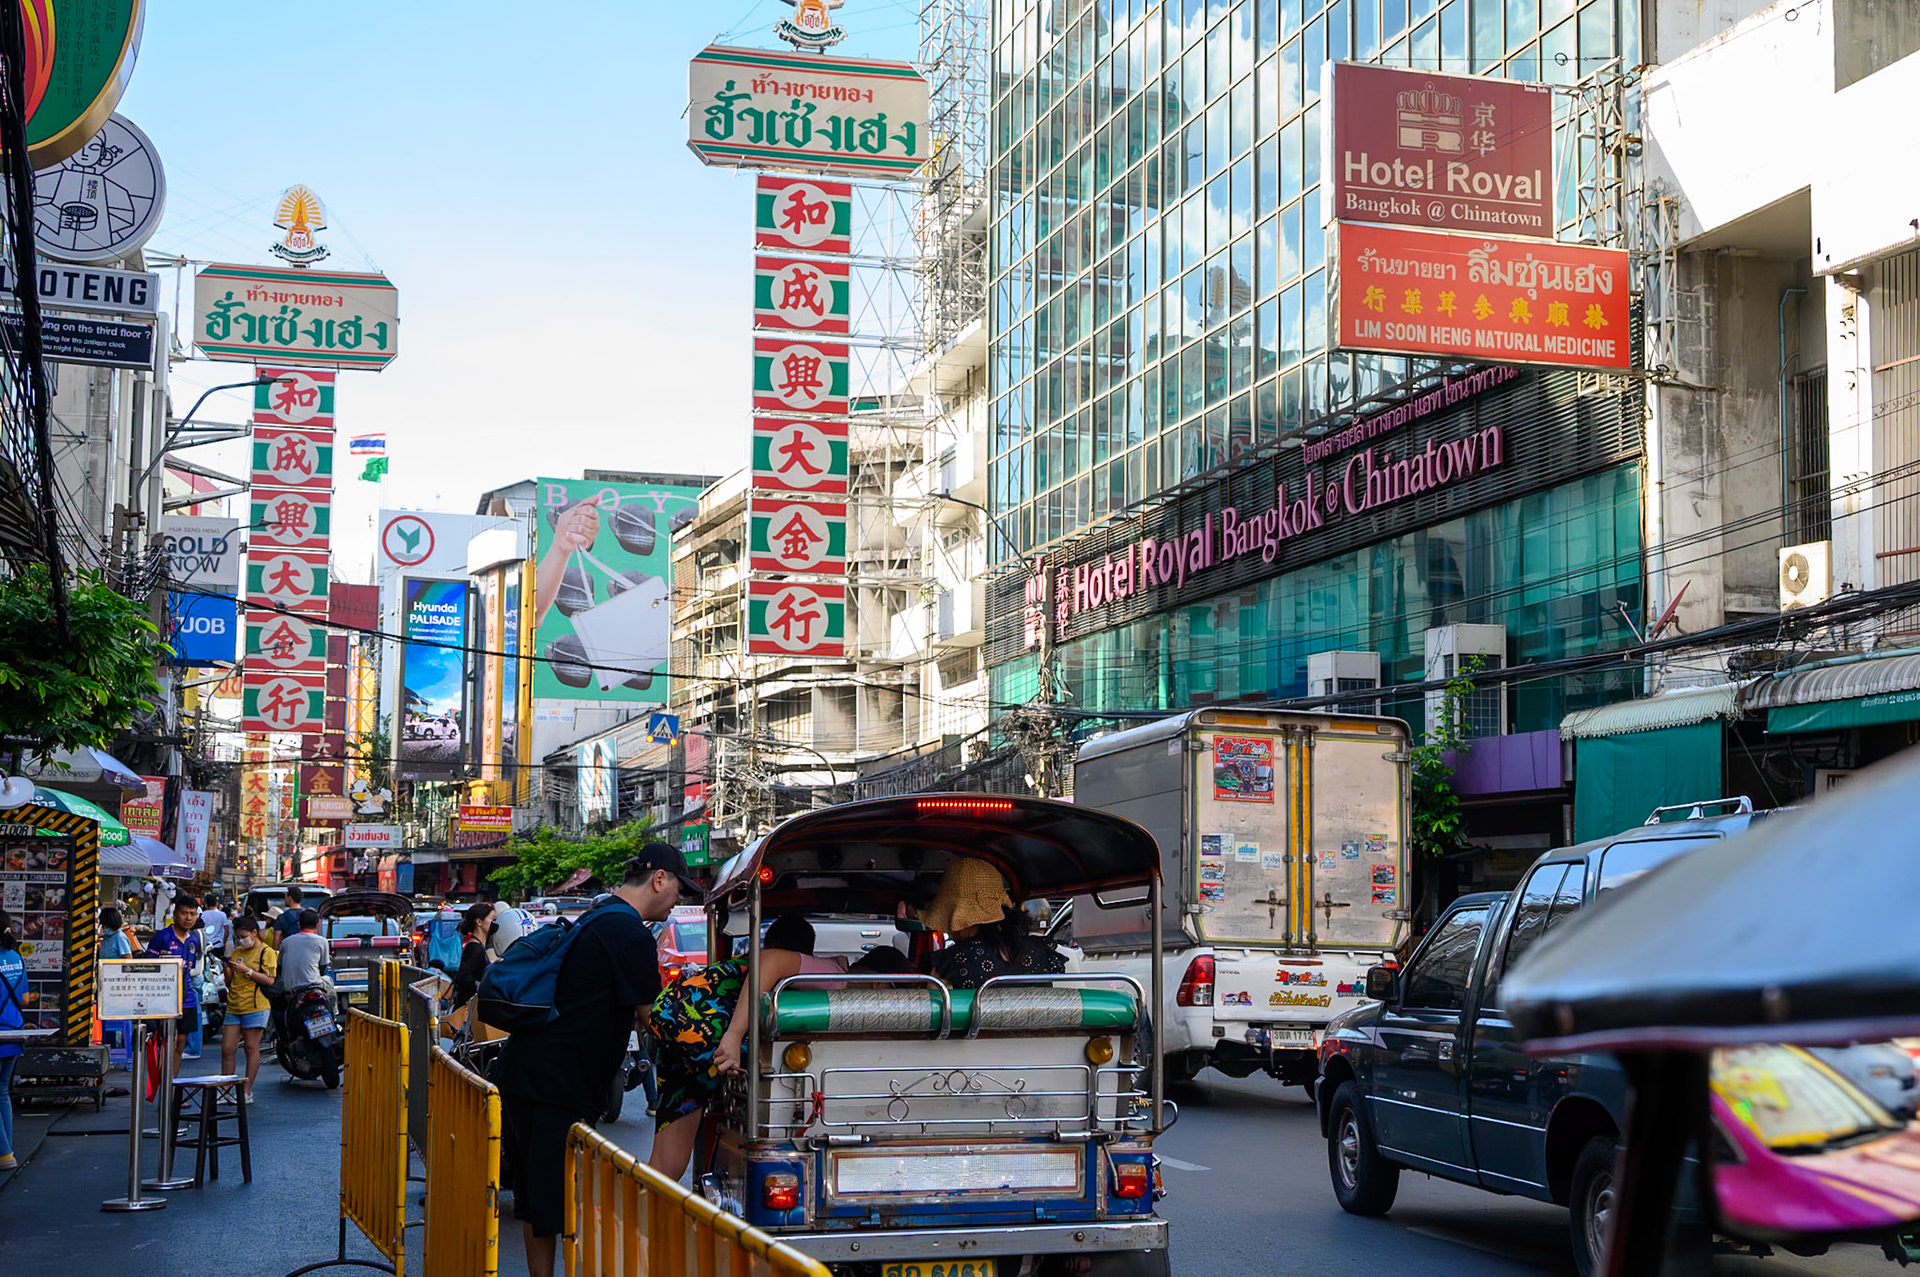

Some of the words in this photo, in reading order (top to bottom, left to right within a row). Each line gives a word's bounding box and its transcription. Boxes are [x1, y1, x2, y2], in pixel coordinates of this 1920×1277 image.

[751, 72, 873, 103] ห้างขายทอง
[704, 79, 917, 157] ฮั่วเซ่งเฮง
[1469, 101, 1496, 158] 京华
[1344, 151, 1434, 191] Hotel
[1345, 192, 1421, 218] Bangkok
[1427, 199, 1446, 222] @
[1450, 203, 1543, 227] Chinatown
[0, 265, 148, 306] LOTENG
[1357, 247, 1457, 281] ร้านขายยา
[1467, 241, 1613, 301] ลิ้มซุ่นเฮง
[245, 284, 344, 308] ห้างขายทอง
[62, 323, 76, 332] on
[78, 322, 94, 333] the
[96, 326, 118, 337] third
[120, 327, 142, 339] floor
[205, 290, 388, 351] ฮั่วเซ่งเฮง
[61, 336, 71, 344] for
[71, 337, 82, 345] the
[108, 341, 126, 350] clock
[1354, 319, 1382, 339] LIM
[1385, 321, 1427, 344] SOON
[1430, 325, 1472, 347] HENG
[1475, 329, 1542, 353] NATURAL
[1544, 336, 1616, 358] MEDICINE
[1301, 438, 1333, 465] โฮเทล
[1367, 402, 1413, 439] บางกอก
[1073, 544, 1137, 614] Hotel
[1141, 511, 1217, 590] Royal
[1221, 483, 1325, 564] Bangkok
[1326, 481, 1342, 513] @
[1344, 424, 1505, 515] Chinatown
[163, 535, 228, 555] GOLD
[171, 555, 220, 573] NOW
[409, 613, 461, 627] PALISADE
[413, 601, 457, 613] Hyundai
[123, 803, 161, 817] เกาลัด
[1293, 1031, 1313, 1041] 1712
[932, 1262, 988, 1277] 6461
